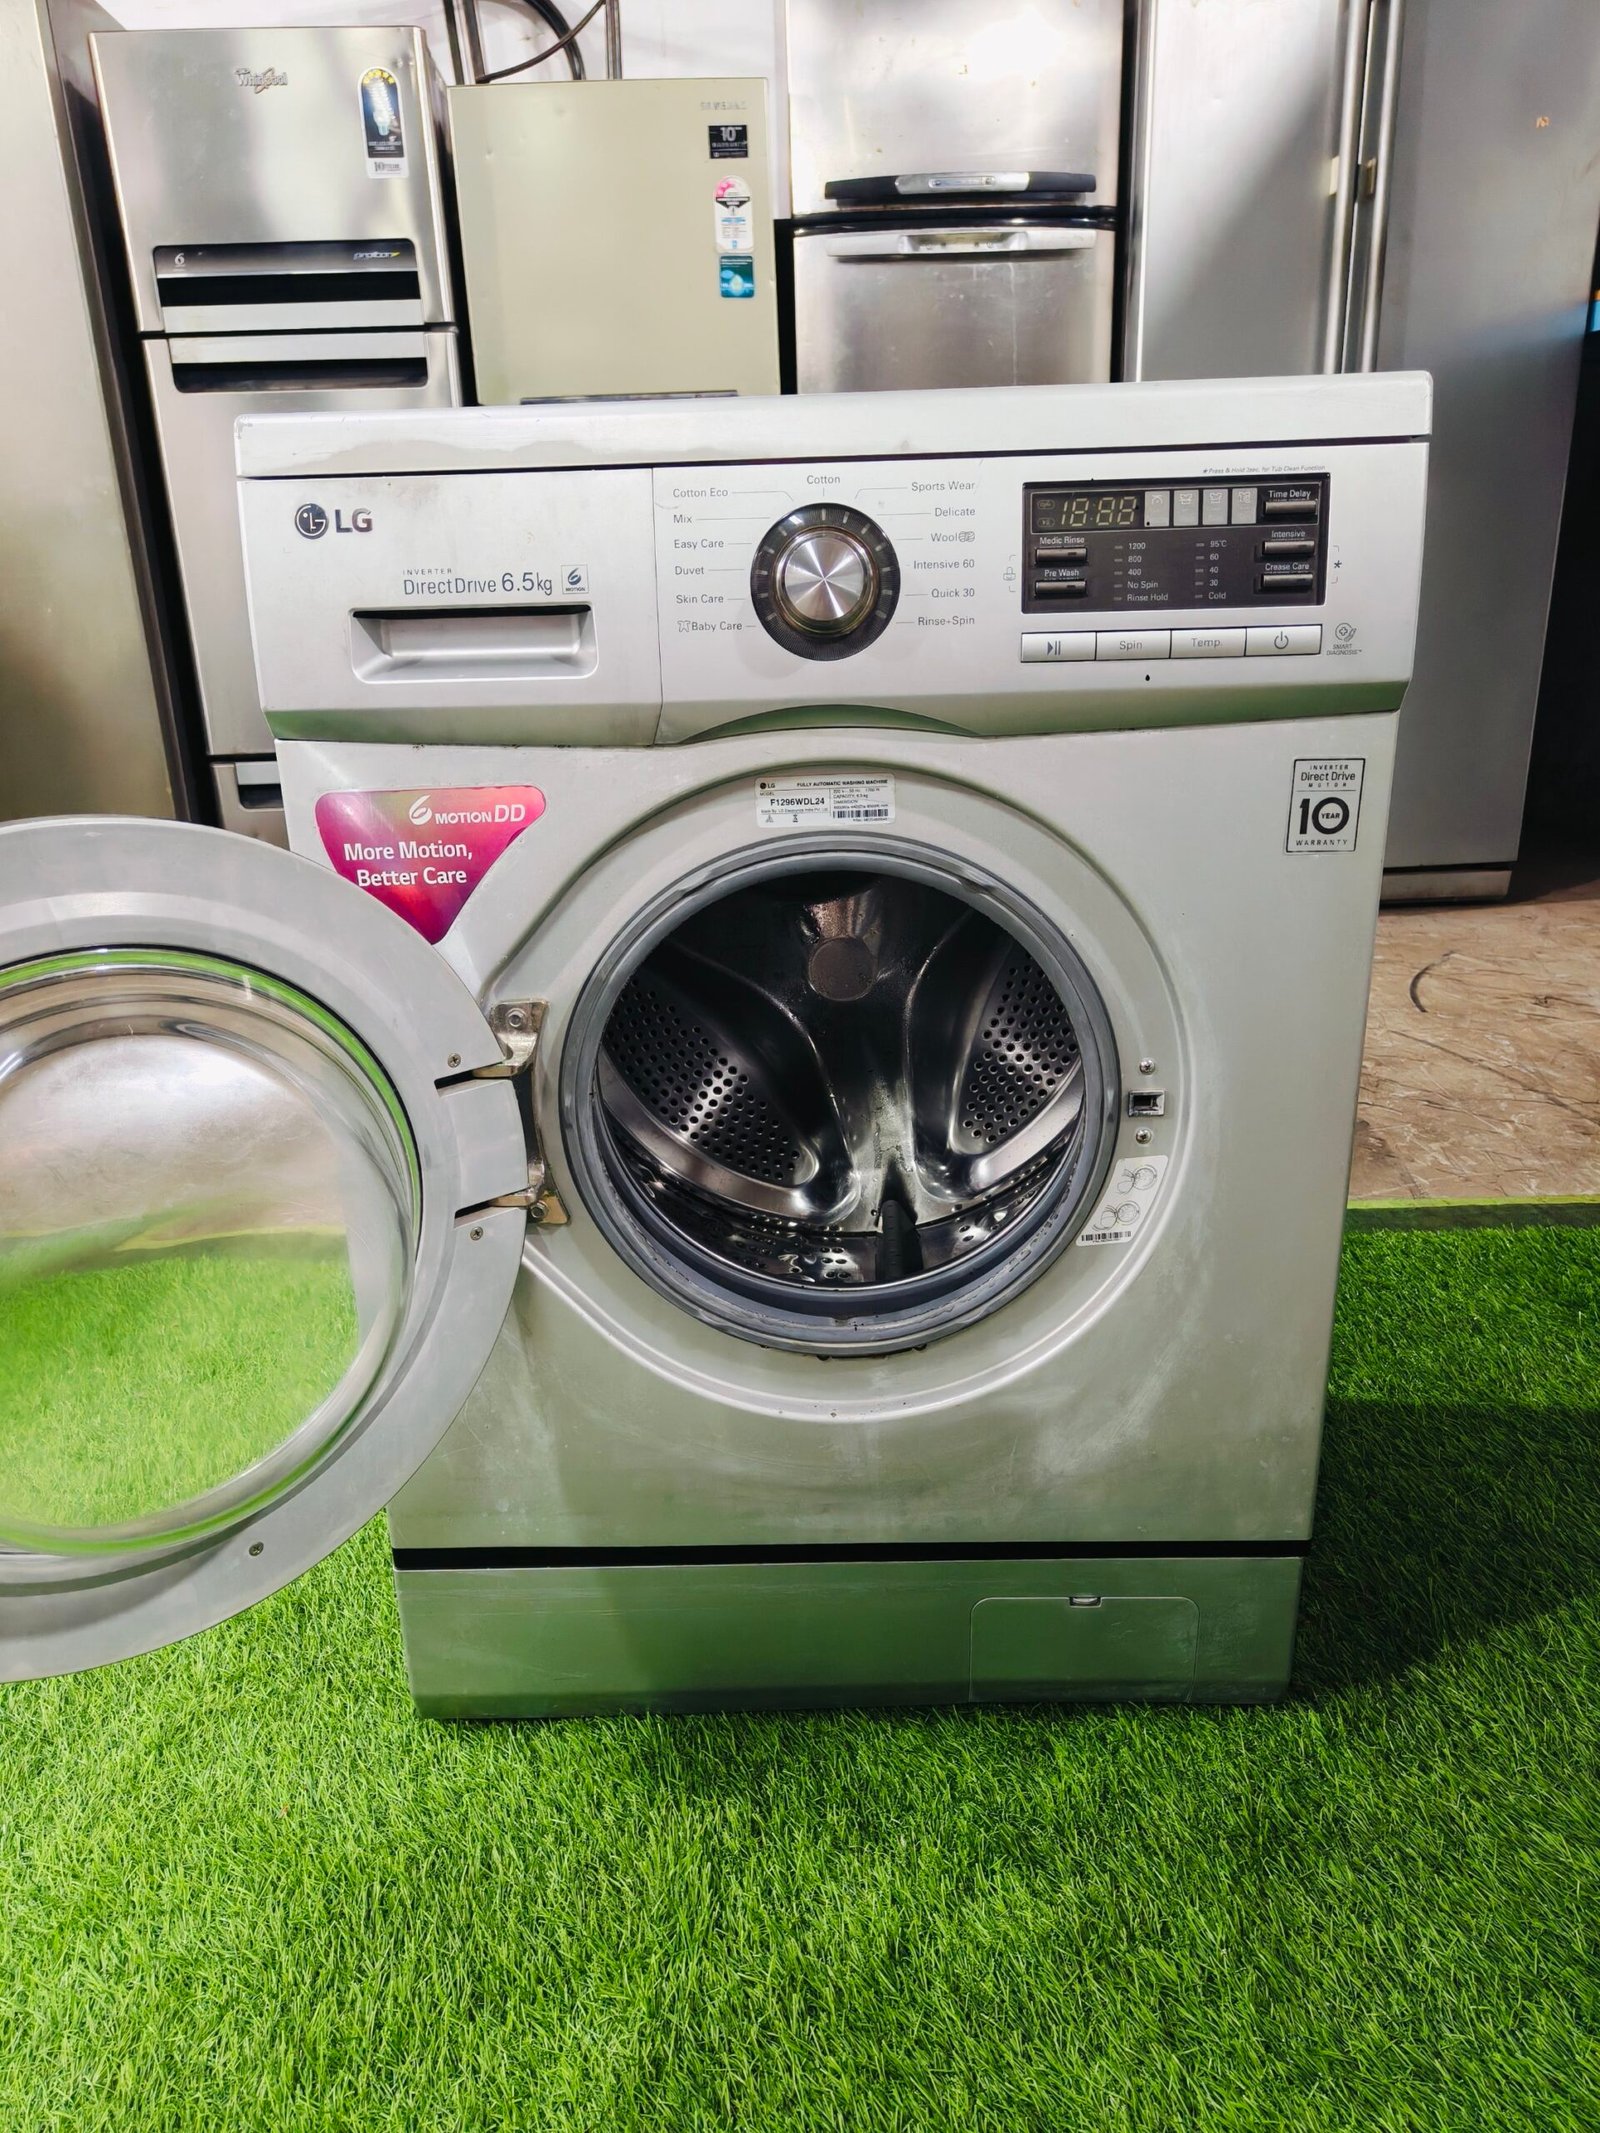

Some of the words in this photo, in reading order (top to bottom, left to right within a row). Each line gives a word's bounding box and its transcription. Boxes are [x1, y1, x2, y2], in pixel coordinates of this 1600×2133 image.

[1301, 464, 1326, 472] Function
[807, 474, 841, 485] Cotton
[911, 482, 946, 493] Sports
[948, 481, 976, 491] Wear
[673, 487, 707, 498] Cotton
[709, 487, 729, 497] Eco
[1268, 490, 1288, 498] Time
[1289, 489, 1311, 499] Delay
[934, 506, 976, 517] Delicate
[335, 508, 373, 533] LG
[673, 514, 692, 524] Mix
[930, 533, 959, 543] Wool
[1271, 530, 1306, 538] Intensive
[673, 539, 698, 551] Easy
[700, 538, 724, 549] Care
[1040, 537, 1062, 545] Medic
[1064, 536, 1085, 544] Rinse
[1128, 542, 1146, 550] 1200
[1128, 555, 1142, 563] 800
[1209, 553, 1219, 561] 60
[913, 559, 960, 570] Intensive
[962, 559, 975, 569] 60
[1265, 563, 1290, 571] Crease
[1292, 562, 1310, 570] Care
[402, 568, 453, 576] INVERTER
[674, 565, 705, 576] Duvet
[1044, 569, 1057, 577] Pre
[1058, 569, 1080, 577] Wash
[1128, 568, 1142, 576] 400
[1209, 566, 1219, 574] 40
[1127, 581, 1138, 589] No
[1140, 581, 1159, 590] Spin
[1209, 579, 1219, 587] 30
[676, 594, 697, 604] Skin
[700, 594, 724, 604] Care
[931, 588, 960, 600] Quick
[962, 588, 975, 598] 30
[1127, 594, 1148, 602] Rinse
[1150, 593, 1168, 601] Hold
[1208, 592, 1227, 600] Cold
[917, 615, 976, 627] Rinse+Spin
[691, 621, 717, 633] Baby
[719, 620, 743, 631] Care
[1119, 640, 1143, 653] Spin
[1191, 637, 1223, 650] Temp.
[1301, 771, 1329, 782] Direct
[1331, 771, 1356, 781] Drive
[770, 797, 825, 807] F1296WDL24
[435, 811, 493, 825] MOTION
[494, 803, 527, 824] DD
[1299, 797, 1350, 835] 10
[343, 842, 394, 861] More
[398, 840, 473, 861] Motion,
[356, 868, 418, 887] Better
[422, 866, 468, 885] Care
